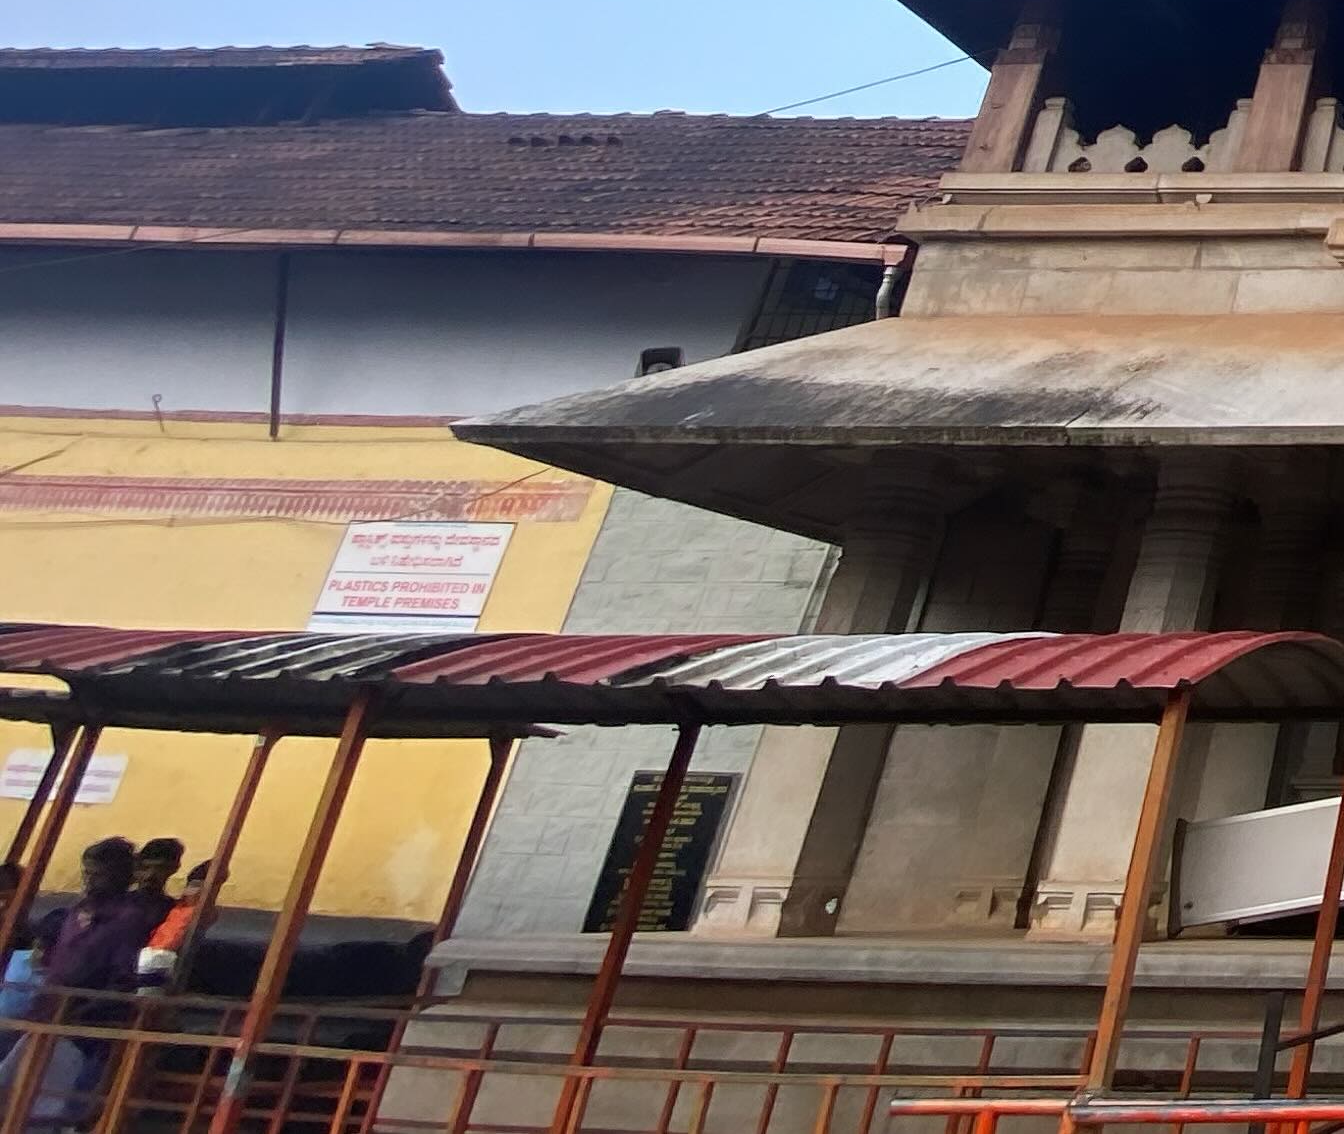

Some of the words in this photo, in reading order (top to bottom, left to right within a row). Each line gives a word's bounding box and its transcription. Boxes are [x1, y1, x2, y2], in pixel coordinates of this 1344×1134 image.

[328, 580, 388, 592] PLASTICS
[392, 581, 470, 594] PROHIBITED
[472, 582, 486, 594] IN
[341, 595, 392, 608] TEMPLE
[394, 597, 460, 610] PREMISES
